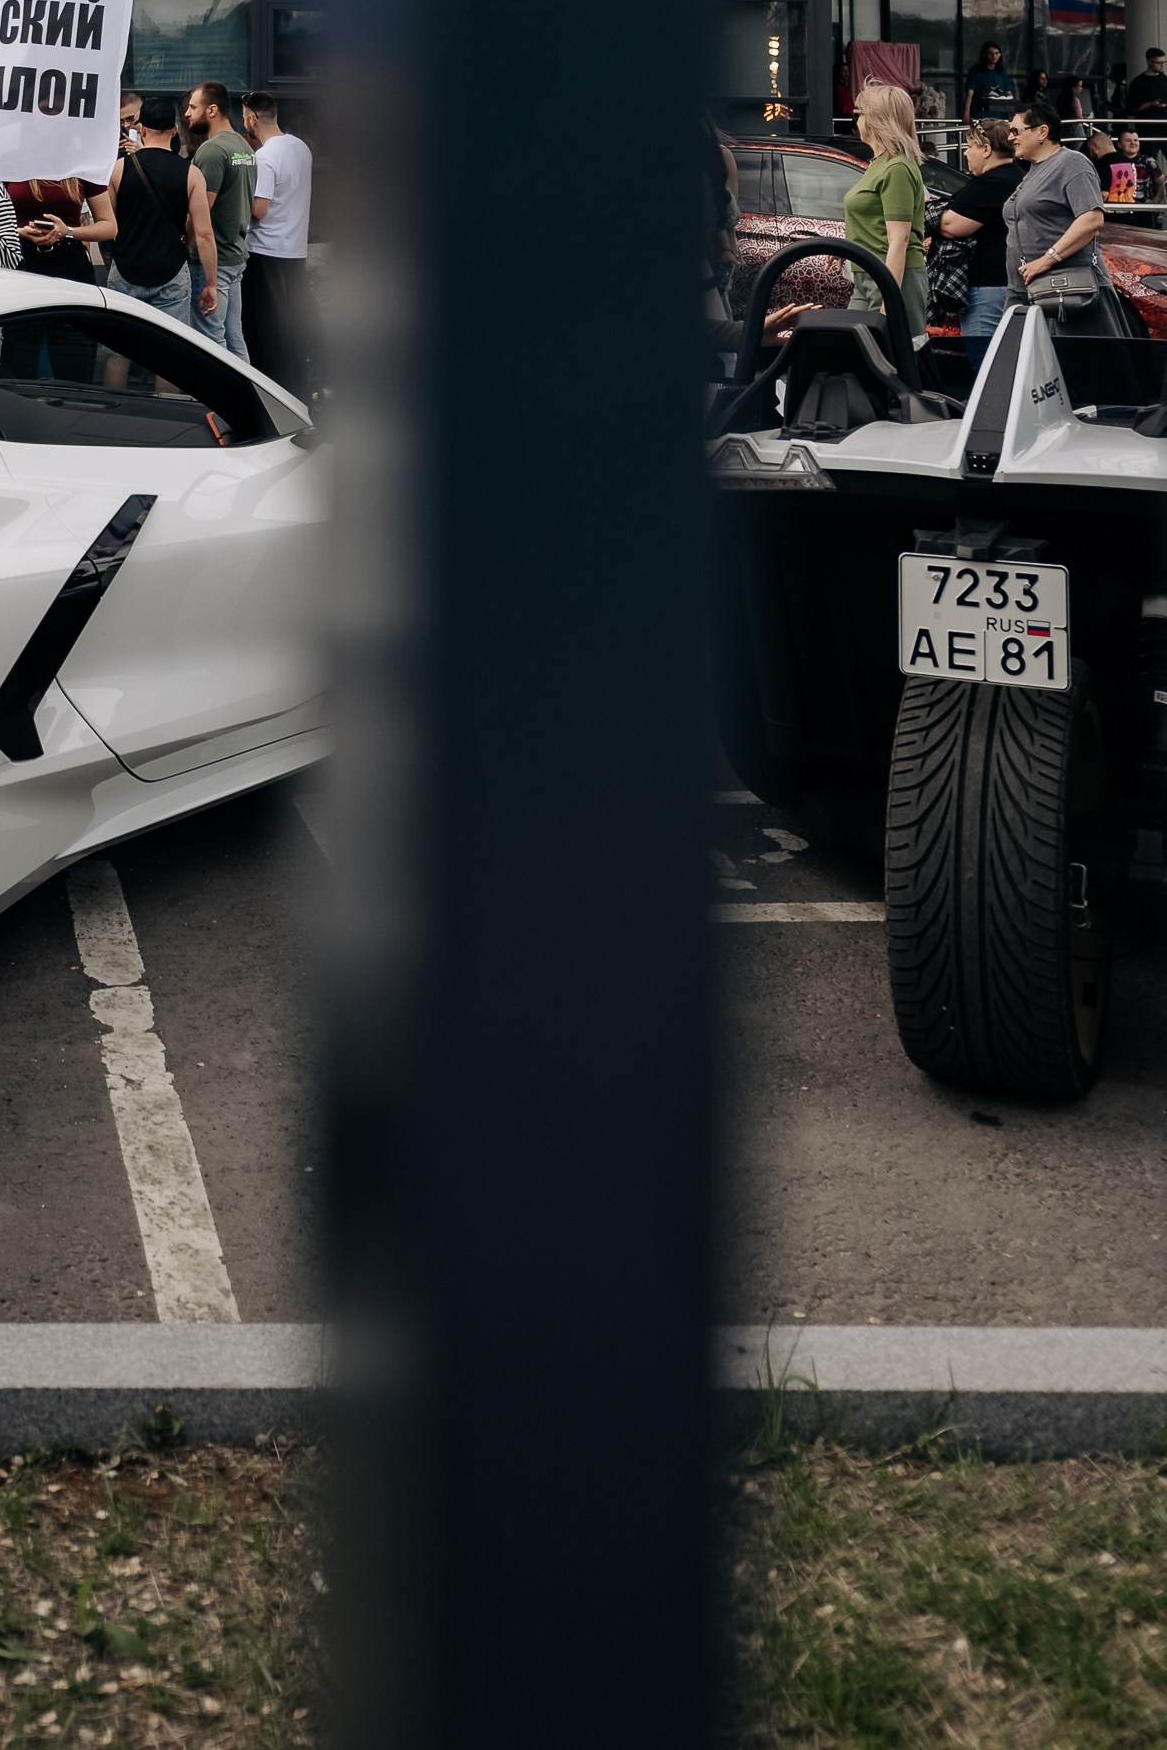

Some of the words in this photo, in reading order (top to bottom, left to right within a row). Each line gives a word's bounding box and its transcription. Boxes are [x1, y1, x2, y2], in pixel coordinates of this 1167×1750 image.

[927, 565, 1039, 612] 7233
[986, 617, 1025, 633] RUS
[1000, 637, 1055, 680] 81
